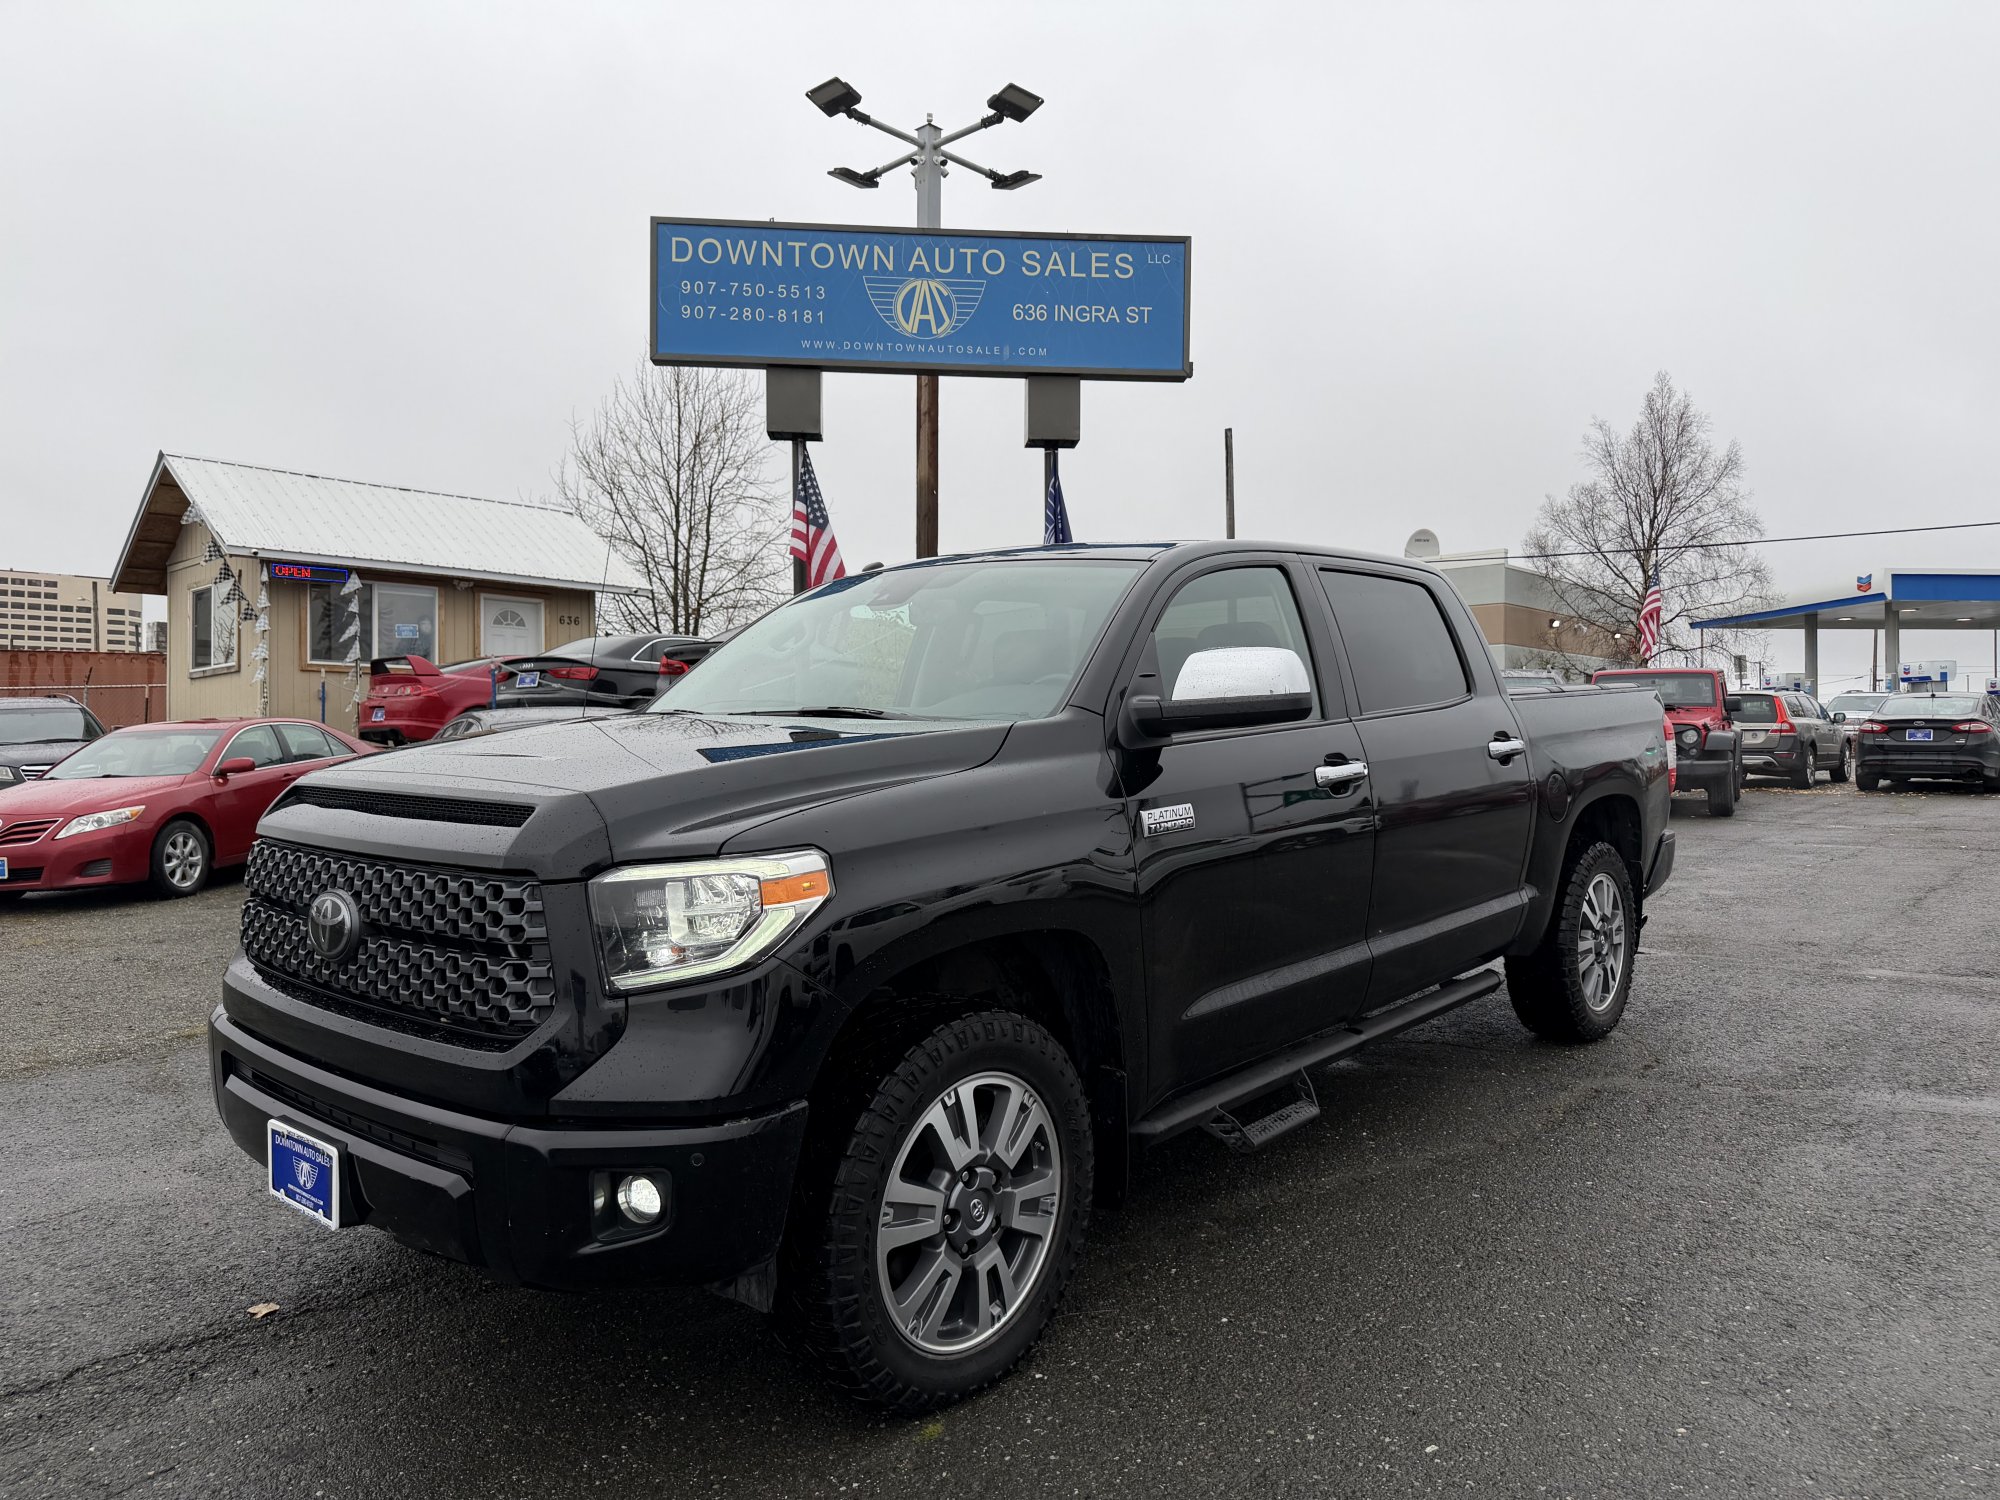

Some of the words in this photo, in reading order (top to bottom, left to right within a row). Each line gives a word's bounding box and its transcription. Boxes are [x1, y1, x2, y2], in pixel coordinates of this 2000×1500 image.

[671, 236, 894, 271] DOWNTOWN
[908, 246, 1005, 275] AUTO
[1021, 250, 1134, 279] SALES
[1147, 253, 1171, 264] LLC
[681, 280, 825, 299] 907-750-5513
[681, 305, 824, 324] 907-280-8181
[1012, 303, 1048, 321] 636
[1054, 305, 1120, 323] INGRA
[1126, 306, 1153, 324] ST
[801, 340, 1047, 357] WWW.DOWNTOWNAUTOSALE.COM
[275, 565, 311, 578] OPEN
[559, 615, 580, 626] 636
[1147, 806, 1192, 822] PLATINUM
[1149, 818, 1194, 833] TUNDRA
[275, 1134, 304, 1153] DOWNTOWN
[303, 1146, 316, 1161] AUTO
